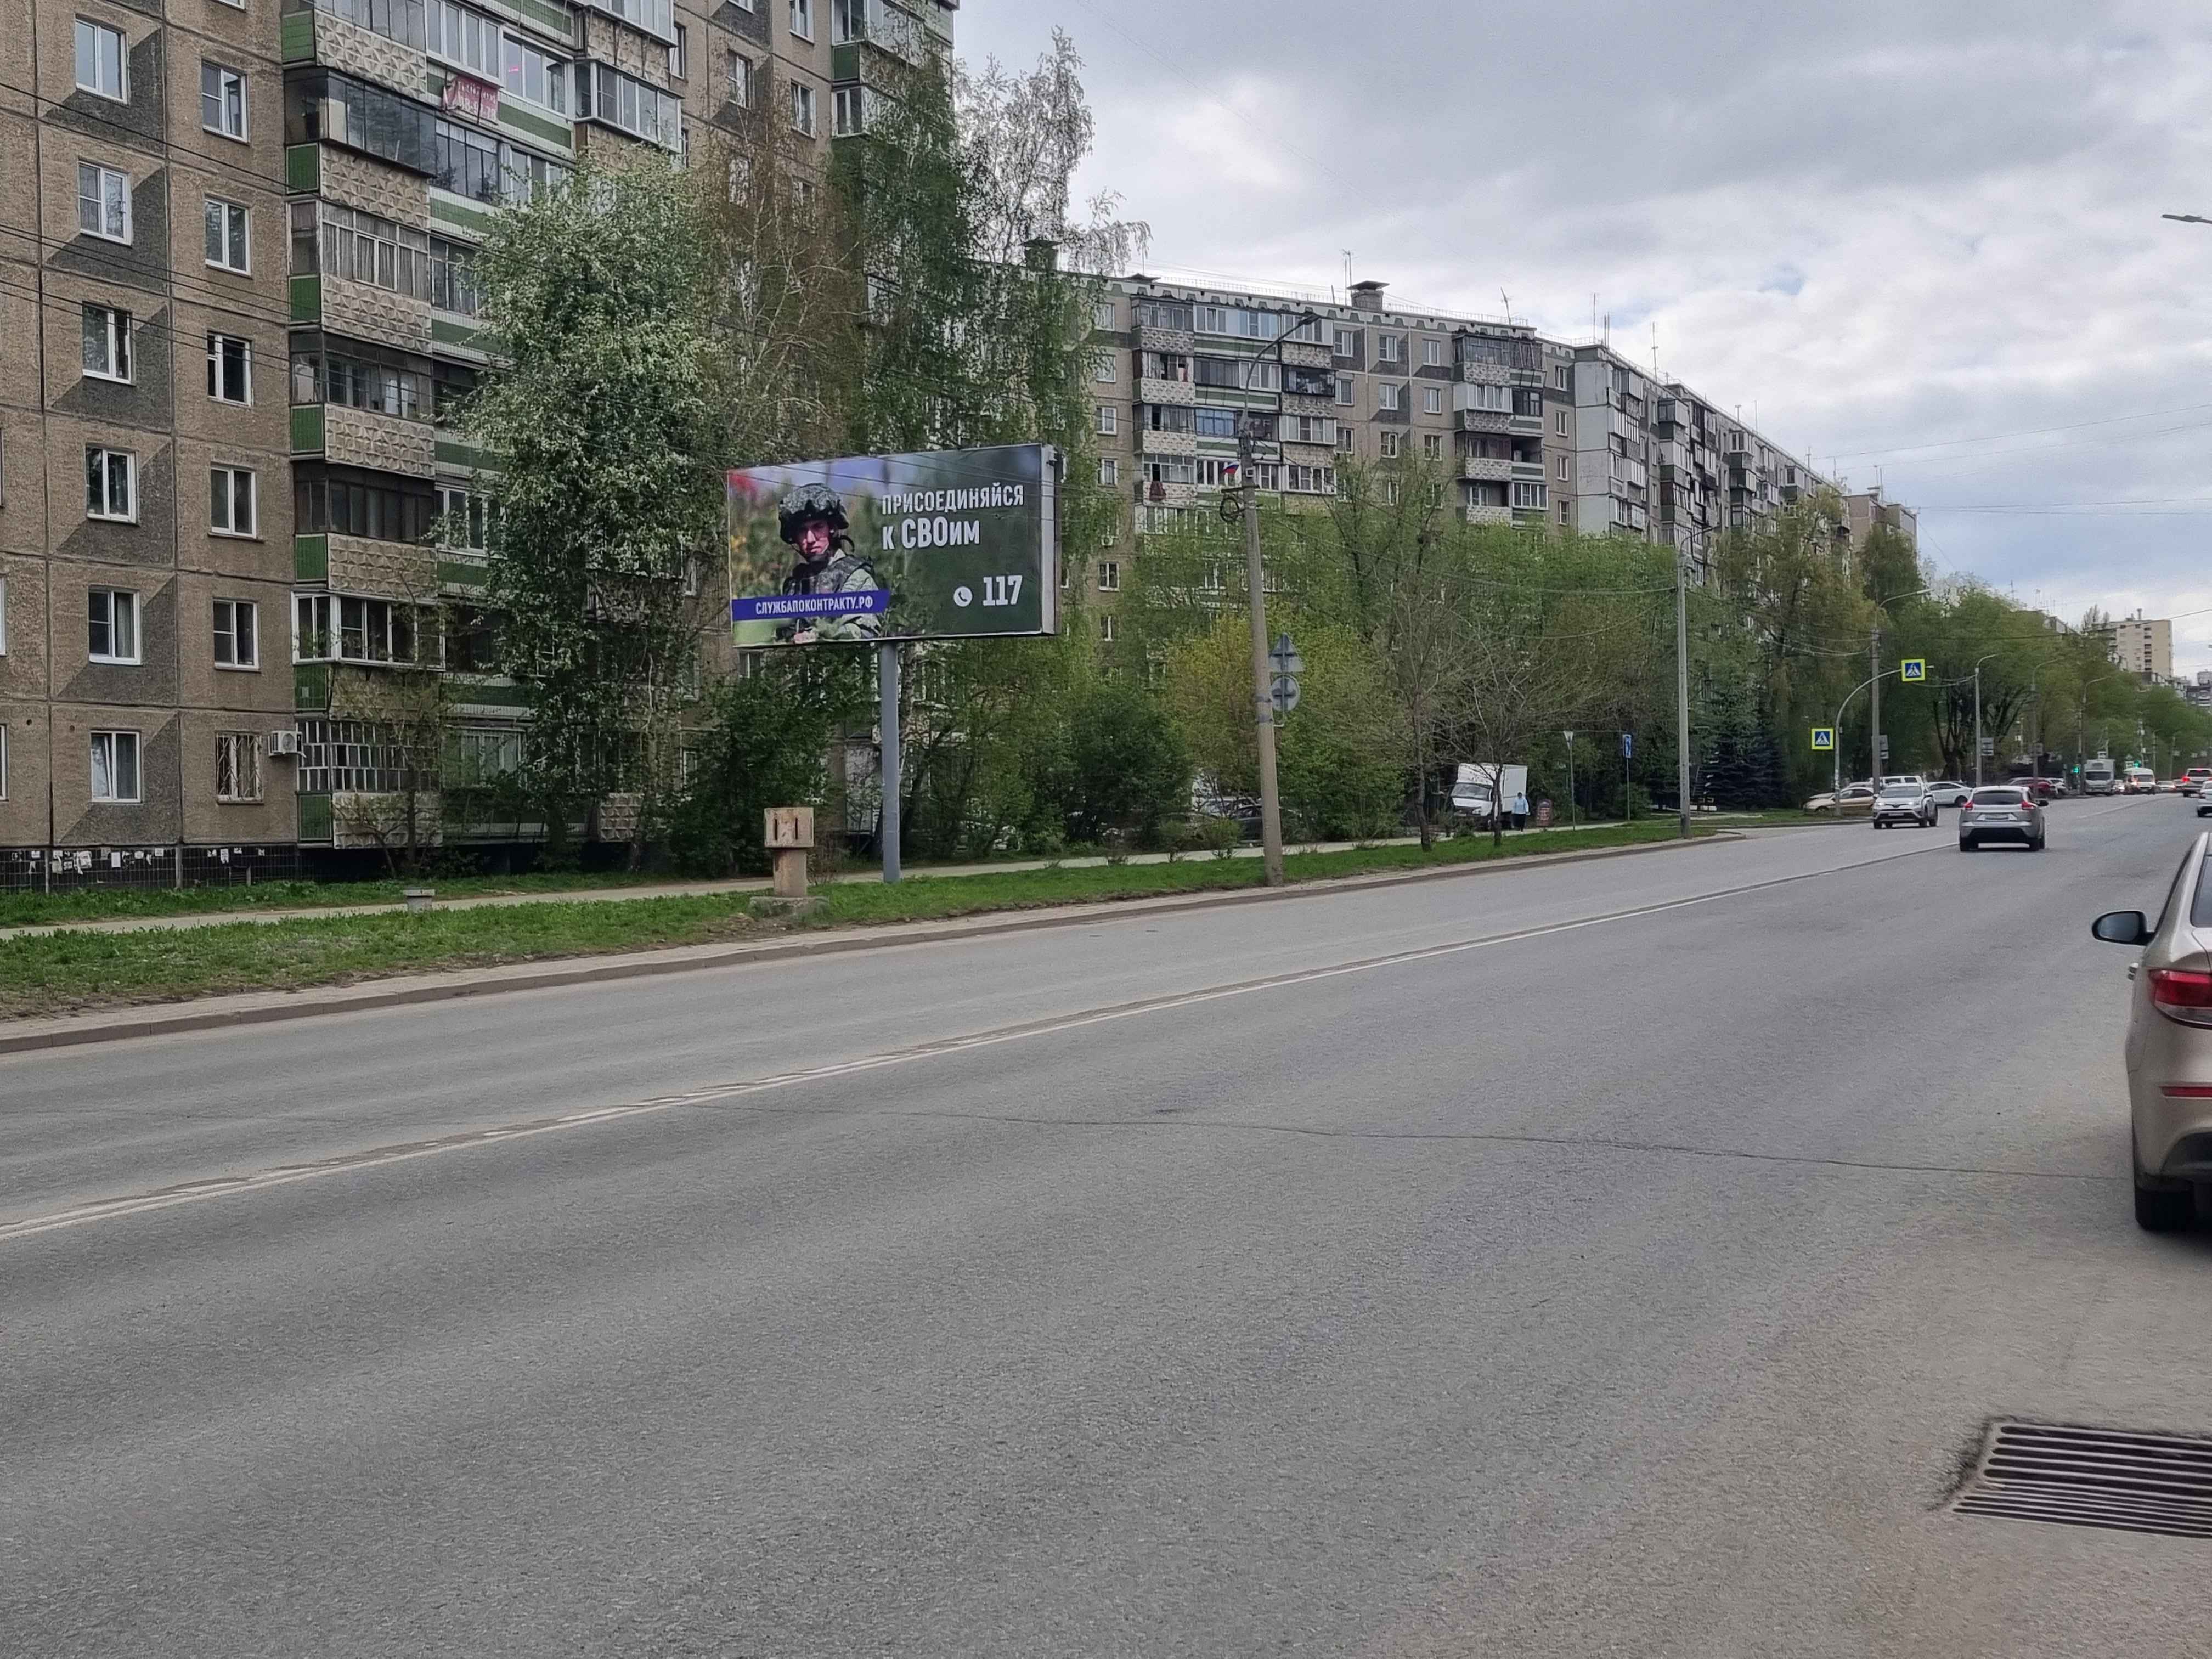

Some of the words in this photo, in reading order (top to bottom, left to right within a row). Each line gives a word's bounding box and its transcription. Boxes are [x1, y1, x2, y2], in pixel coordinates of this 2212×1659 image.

[882, 482, 1024, 515] ПРИСОЕДИНЯЙСЯ
[755, 595, 873, 615] СЛУЖБАПОКОНТРАКТУ.РФ
[983, 575, 1023, 606] 117
